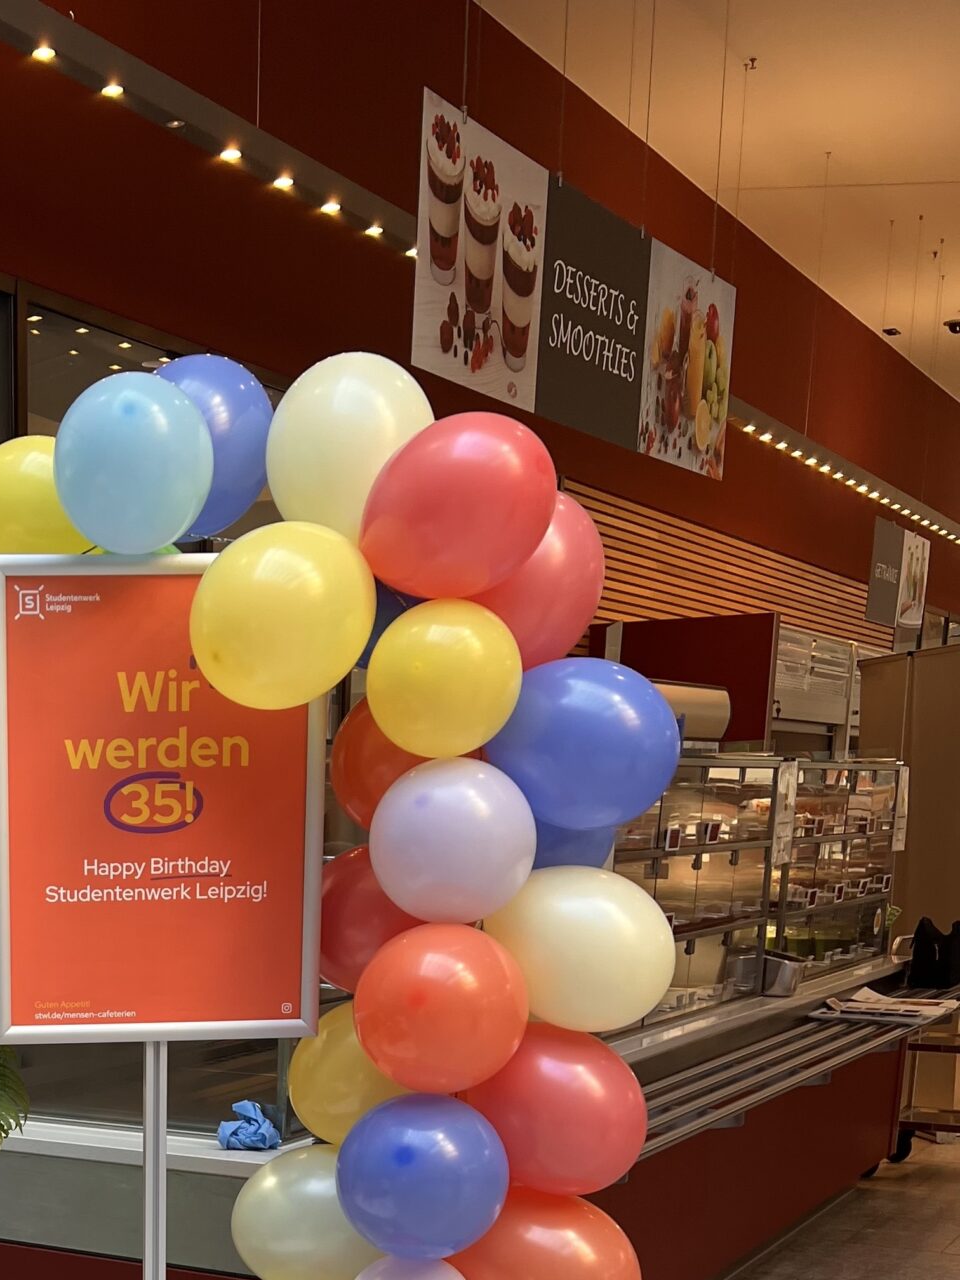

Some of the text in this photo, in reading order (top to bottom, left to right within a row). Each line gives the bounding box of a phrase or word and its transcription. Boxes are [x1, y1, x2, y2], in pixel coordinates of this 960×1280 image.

[554, 260, 639, 335] DESSERTS &
[549, 313, 636, 381] SMOOTHIES
[45, 593, 100, 602] Studentenwerk
[45, 603, 72, 613] Leipzig
[117, 669, 200, 712] Wir
[64, 726, 249, 769] werden
[120, 781, 194, 824] 35!
[83, 857, 231, 879] Happy Birthday
[45, 881, 267, 902] Studentenwerk Leipzig!
[35, 1010, 136, 1020] stwl.de/mensen-cafeterien
